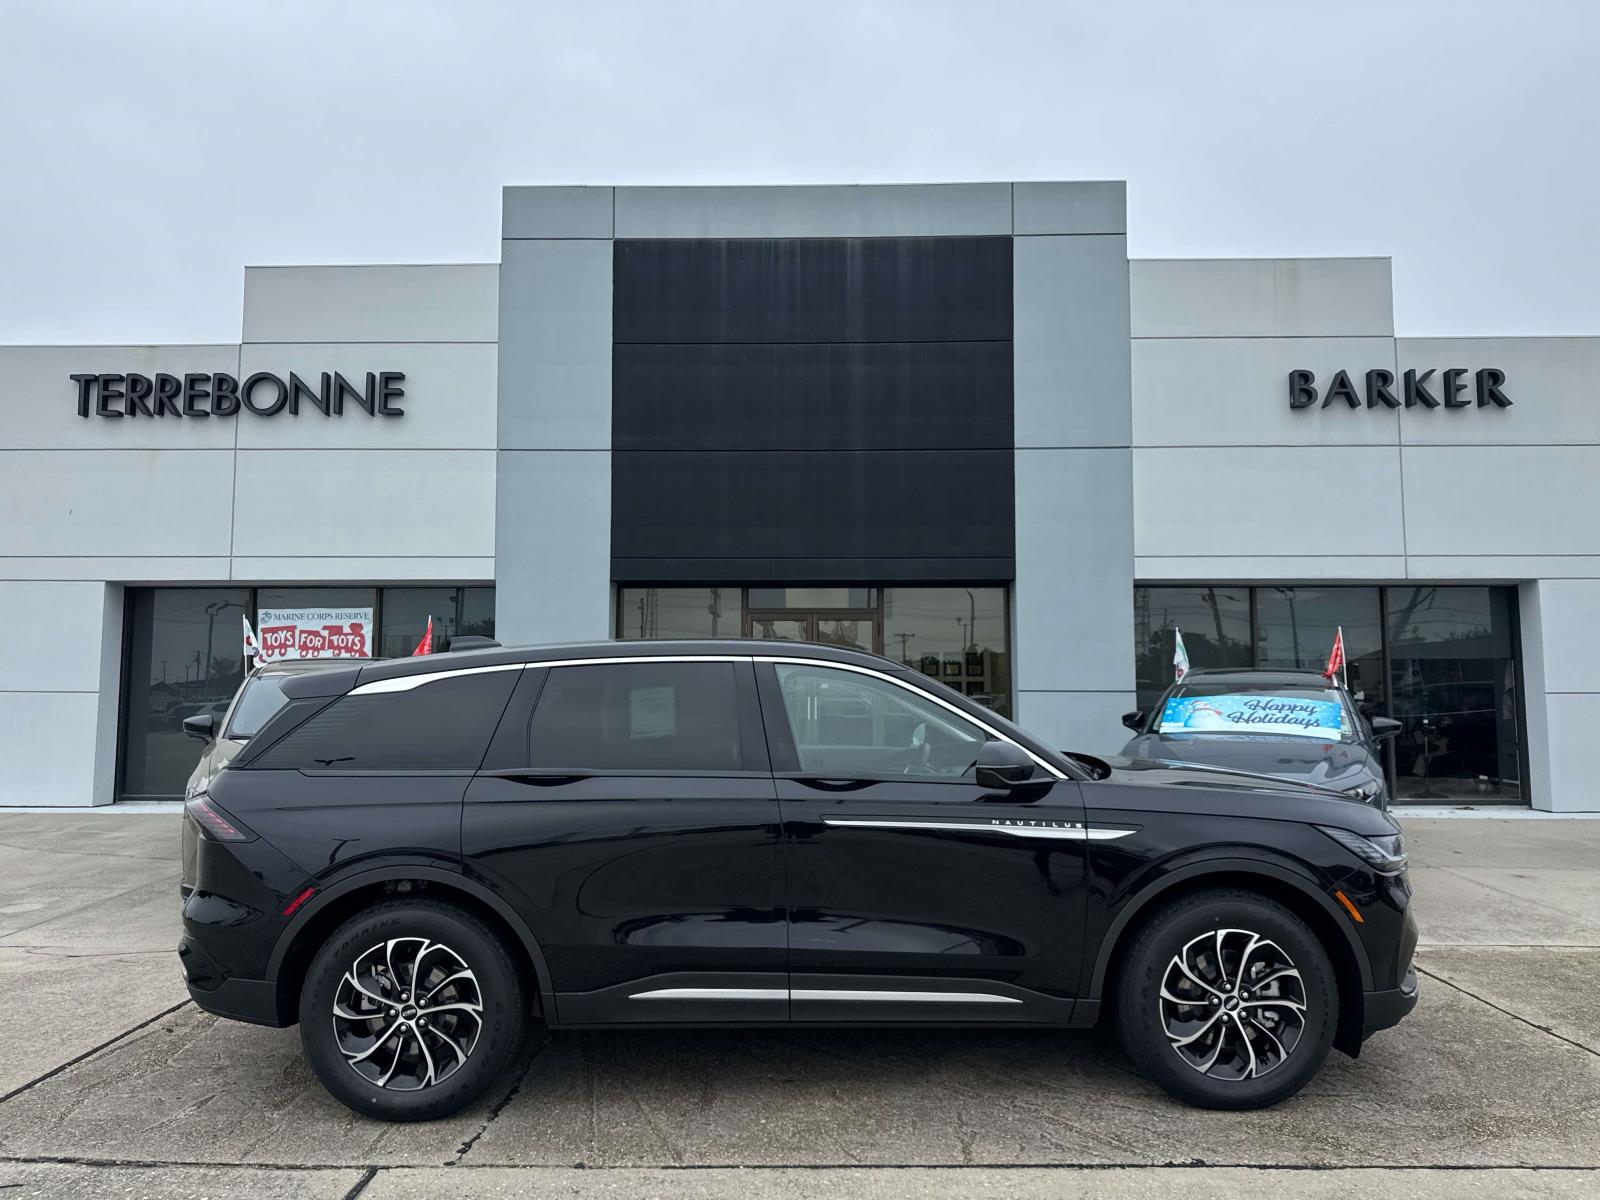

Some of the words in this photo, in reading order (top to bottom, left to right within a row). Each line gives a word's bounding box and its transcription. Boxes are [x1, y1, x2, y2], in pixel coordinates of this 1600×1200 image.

[70, 371, 406, 417] TERREBONNE
[1289, 368, 1514, 409] BARKER
[273, 612, 306, 620] MARINE
[306, 612, 334, 620] CORPS
[335, 612, 369, 620] RESERVE
[264, 630, 294, 646] TOYS
[300, 633, 323, 648] FOR
[330, 635, 361, 650] TOTS
[1243, 699, 1318, 715] Happy
[1227, 711, 1320, 729] Holidays
[991, 819, 1082, 828] NAUTILUS
